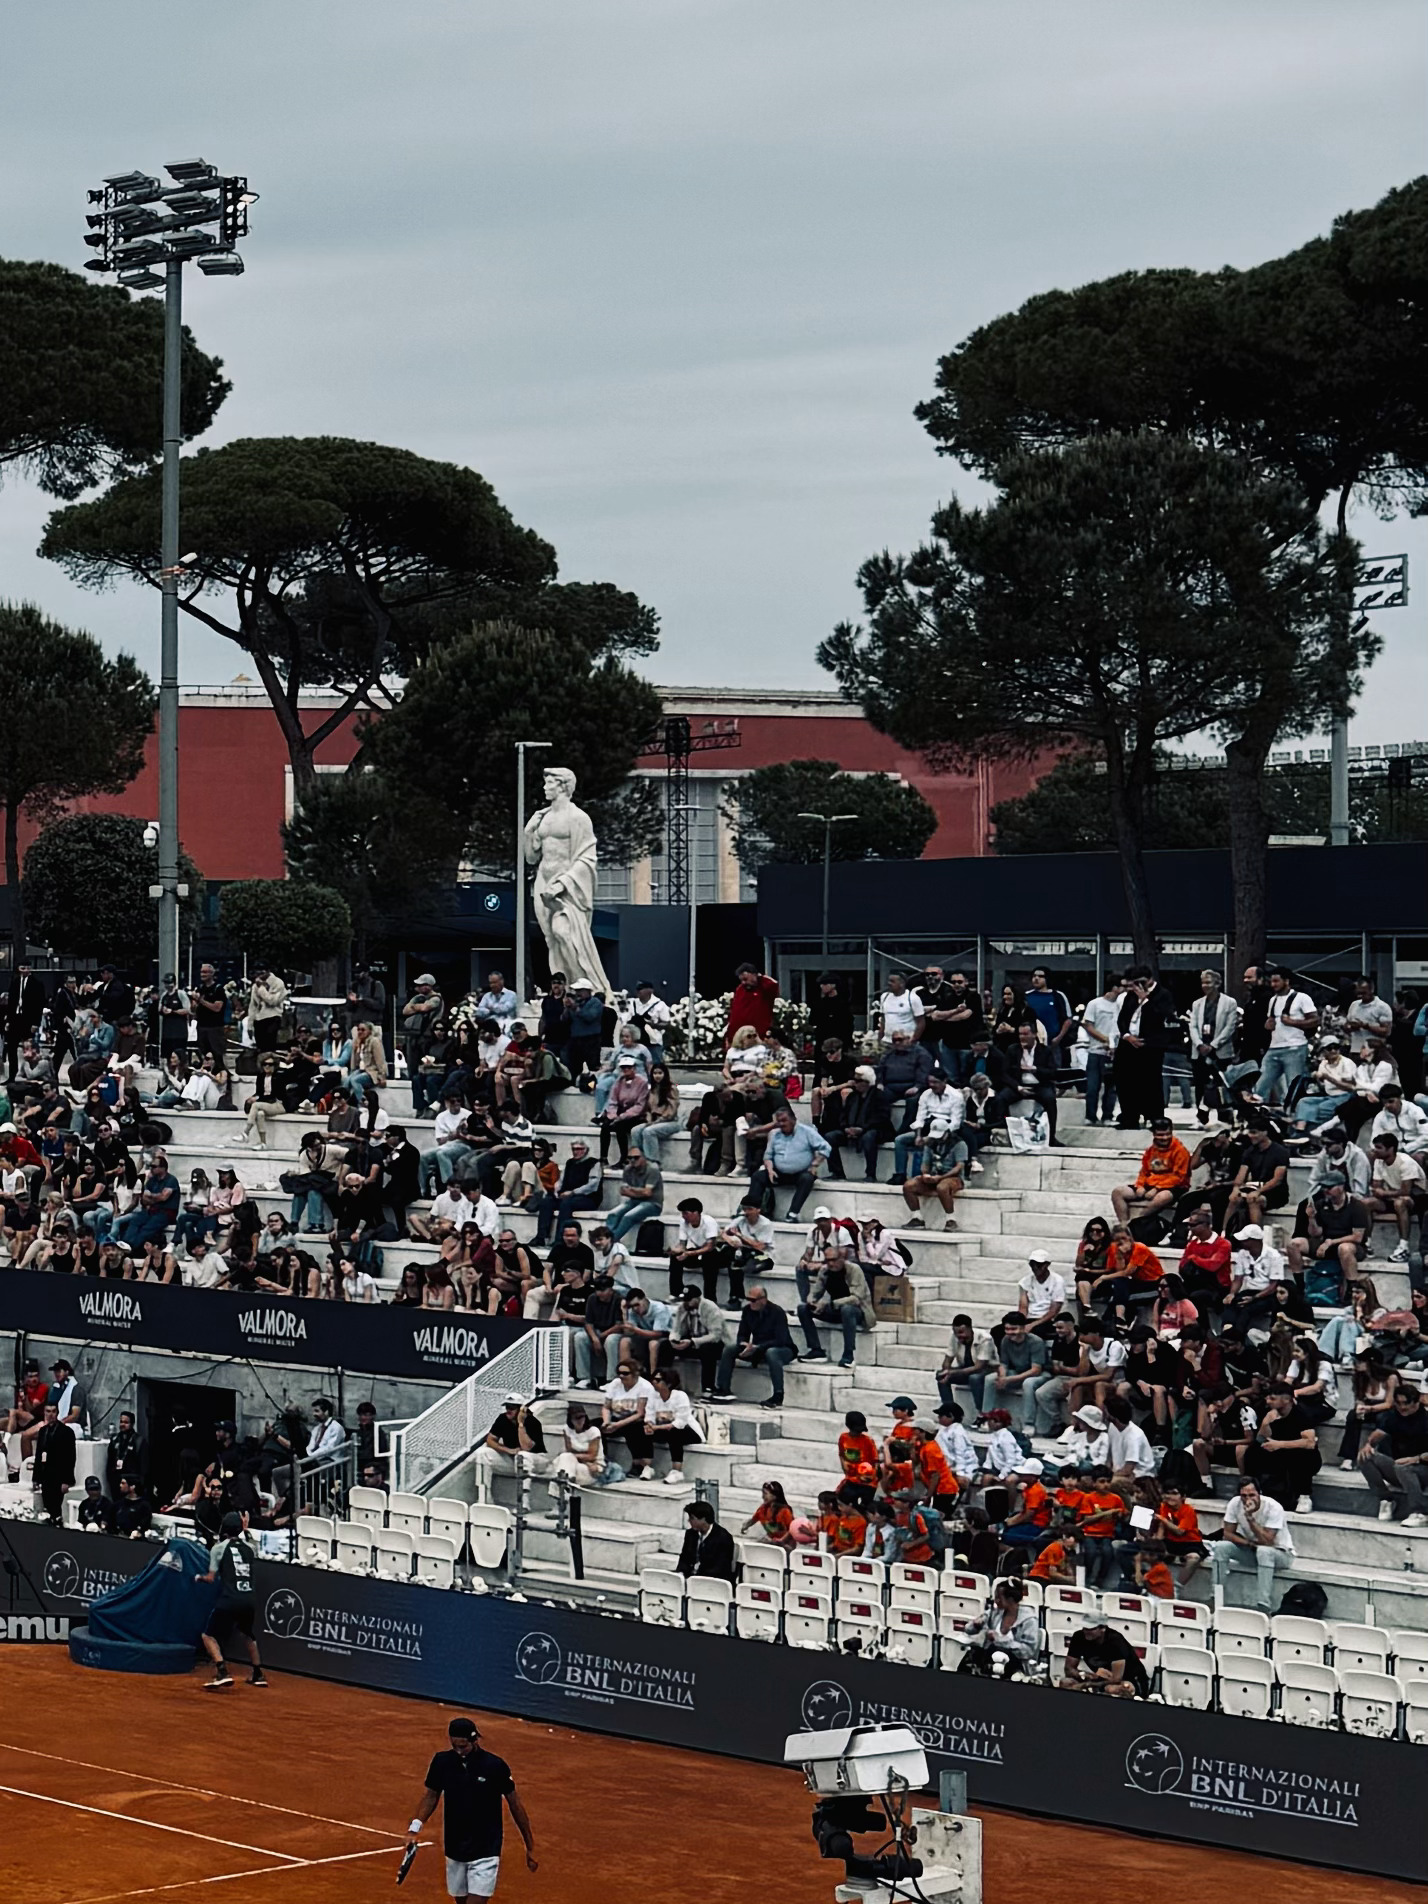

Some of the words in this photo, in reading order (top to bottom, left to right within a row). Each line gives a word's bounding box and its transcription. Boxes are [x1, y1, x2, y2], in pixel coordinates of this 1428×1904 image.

[79, 1291, 142, 1321] VALMORA
[238, 1308, 307, 1339] VALMORA
[413, 1326, 490, 1358] VALMORA
[83, 1581, 115, 1597] BN
[309, 1621, 352, 1643] BNL
[356, 1630, 422, 1655] D'ITALIA
[310, 1607, 423, 1637] INTERNAZIONALI
[567, 1651, 696, 1685] INTERNAZIONALI
[565, 1666, 616, 1691] BNL
[619, 1677, 694, 1705] D'ITALIA
[859, 1701, 1005, 1738] INTERNAZIONALI
[921, 1730, 1003, 1760] D'ITALIA
[1192, 1756, 1361, 1797] INTERNAZIONALI
[1191, 1773, 1255, 1802] BNL
[1261, 1787, 1358, 1820] D'ITALIA
